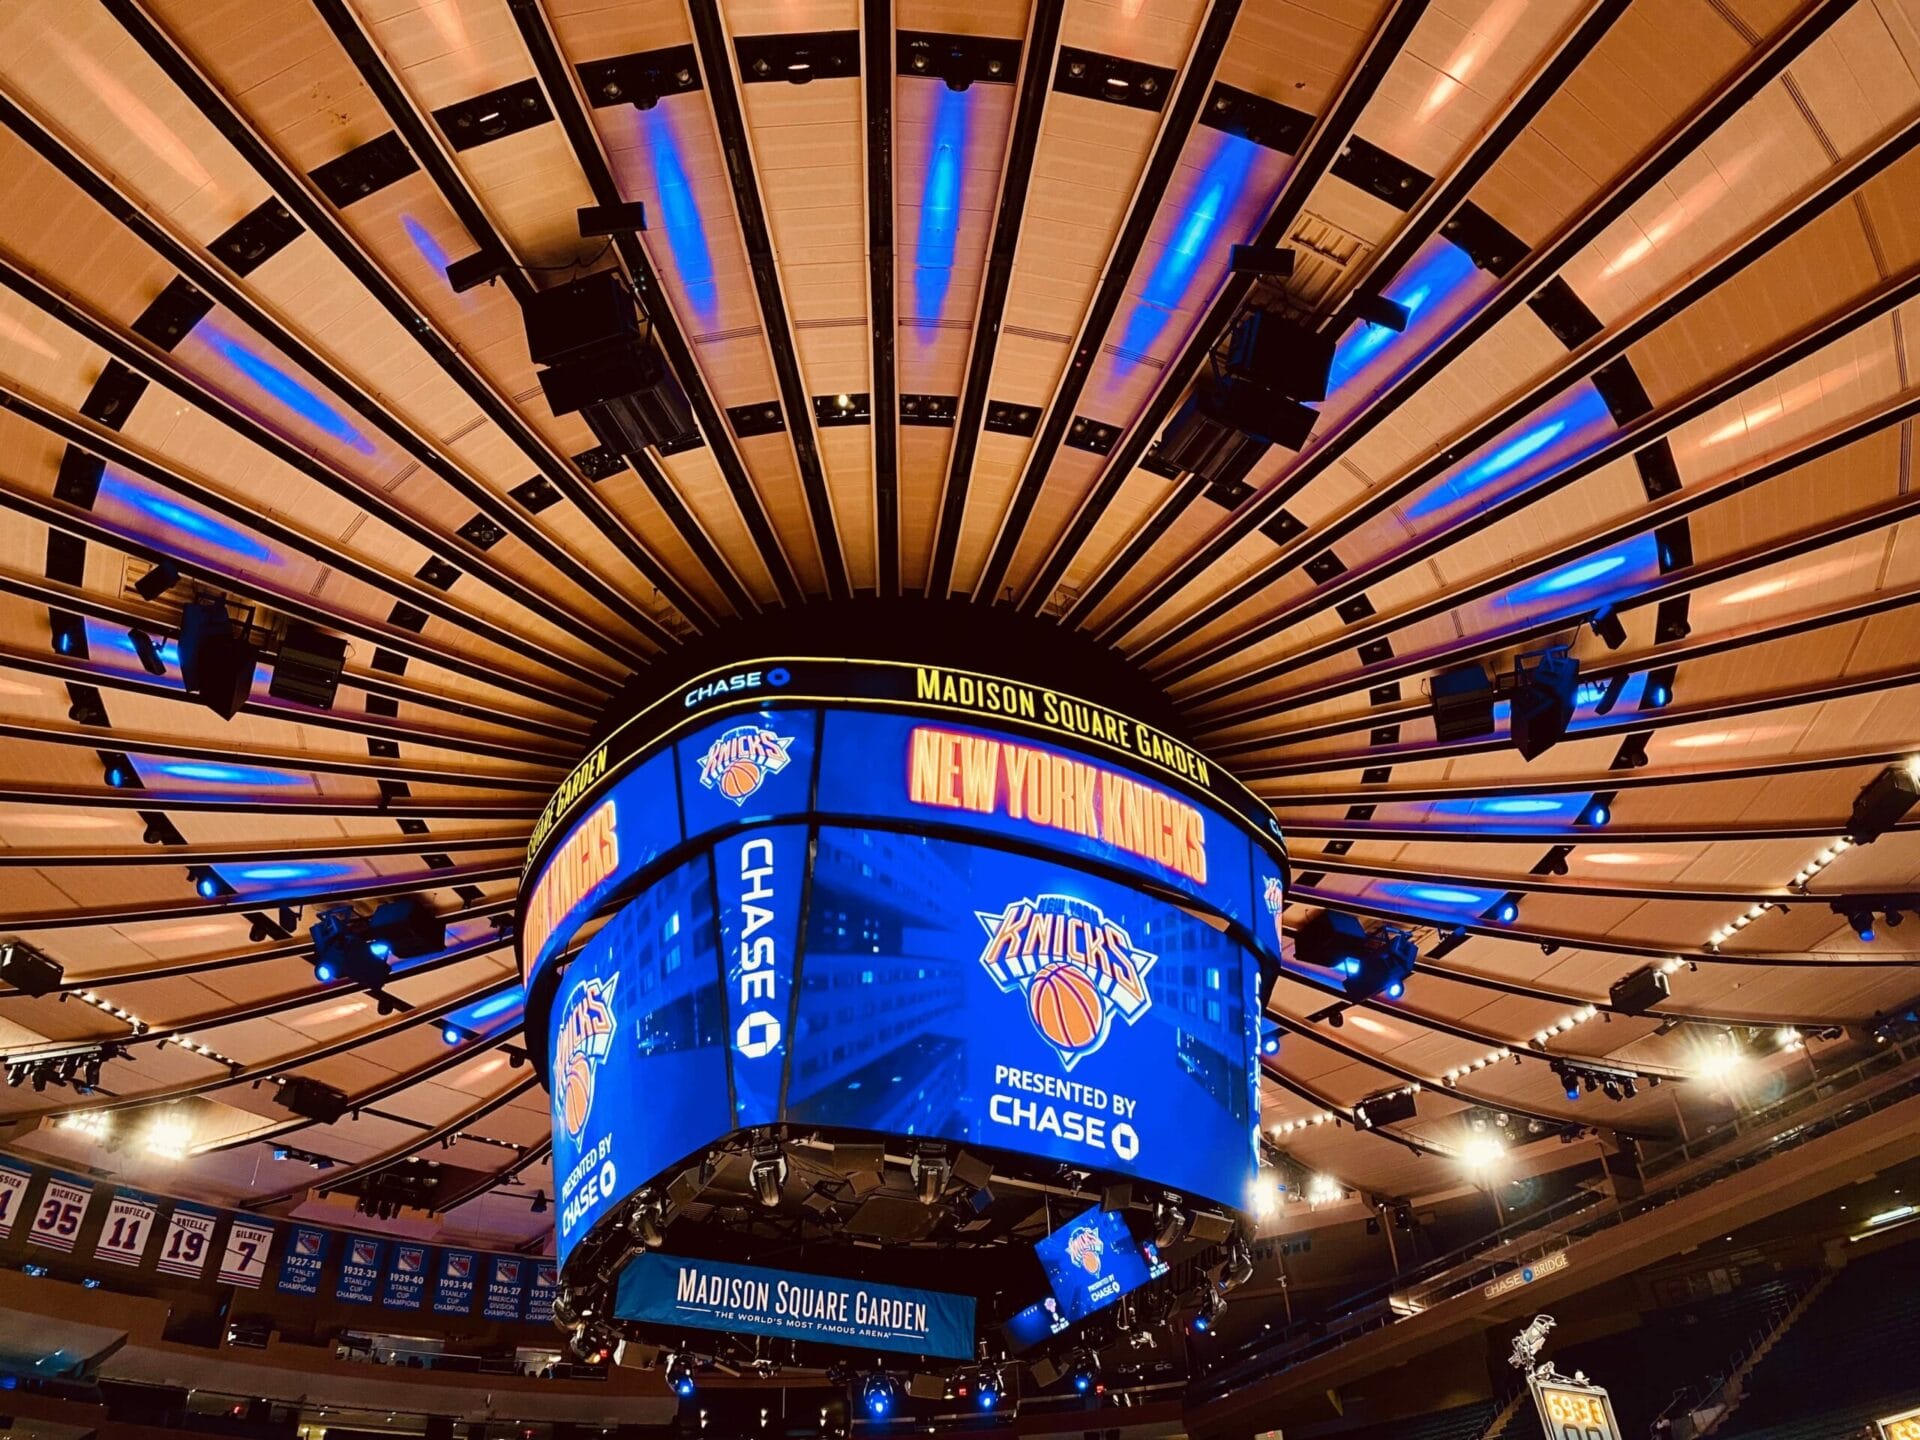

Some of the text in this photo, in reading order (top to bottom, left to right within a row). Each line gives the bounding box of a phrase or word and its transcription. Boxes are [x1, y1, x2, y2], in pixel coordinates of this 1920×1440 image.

[684, 671, 762, 708] CHASE
[916, 667, 1210, 788] MADISON SQUARE GARDEN
[702, 731, 786, 781] KNICKS
[556, 745, 608, 818] GARDEN
[909, 728, 1208, 885] NEW YORK KNICKS
[741, 838, 776, 1006] CHASE
[985, 904, 1146, 1005] KNICKS
[995, 1064, 1137, 1119] PRESENTED BY
[989, 1093, 1106, 1149] CHASE
[561, 1133, 613, 1204] PRESENTED BY
[38, 1199, 83, 1236] 35
[562, 1174, 599, 1238] CHASE
[107, 1217, 141, 1250] 11
[167, 1229, 205, 1262] 19
[238, 1242, 258, 1272] 7
[286, 1255, 322, 1270] 1927-28
[343, 1265, 377, 1279] 1932-33
[343, 1276, 372, 1287] STANLEY
[390, 1273, 424, 1285] 1939-40
[439, 1279, 473, 1290] 1993-94
[1484, 1253, 1569, 1298] CHASE BRIDGE
[278, 1281, 317, 1293] CHAMPIONS
[336, 1290, 373, 1302] CHAMPIONS
[349, 1285, 363, 1293] CUP
[391, 1284, 419, 1293] STANLEY
[396, 1291, 410, 1299] CUP
[441, 1289, 468, 1299] STANLEY
[489, 1284, 521, 1296] 1926-27
[676, 1267, 770, 1313] MADISON
[775, 1279, 850, 1323] SQUARE
[1090, 1284, 1115, 1302] CHASE
[383, 1298, 420, 1308] CHAMPIONS
[433, 1303, 470, 1313] CHAMPIONS
[483, 1309, 519, 1318] CHAMPIONS
[715, 1310, 735, 1320] THE
[737, 1312, 783, 1326] WORLD'S
[786, 1319, 814, 1330] MOST
[816, 1322, 856, 1335] FAMOUS
